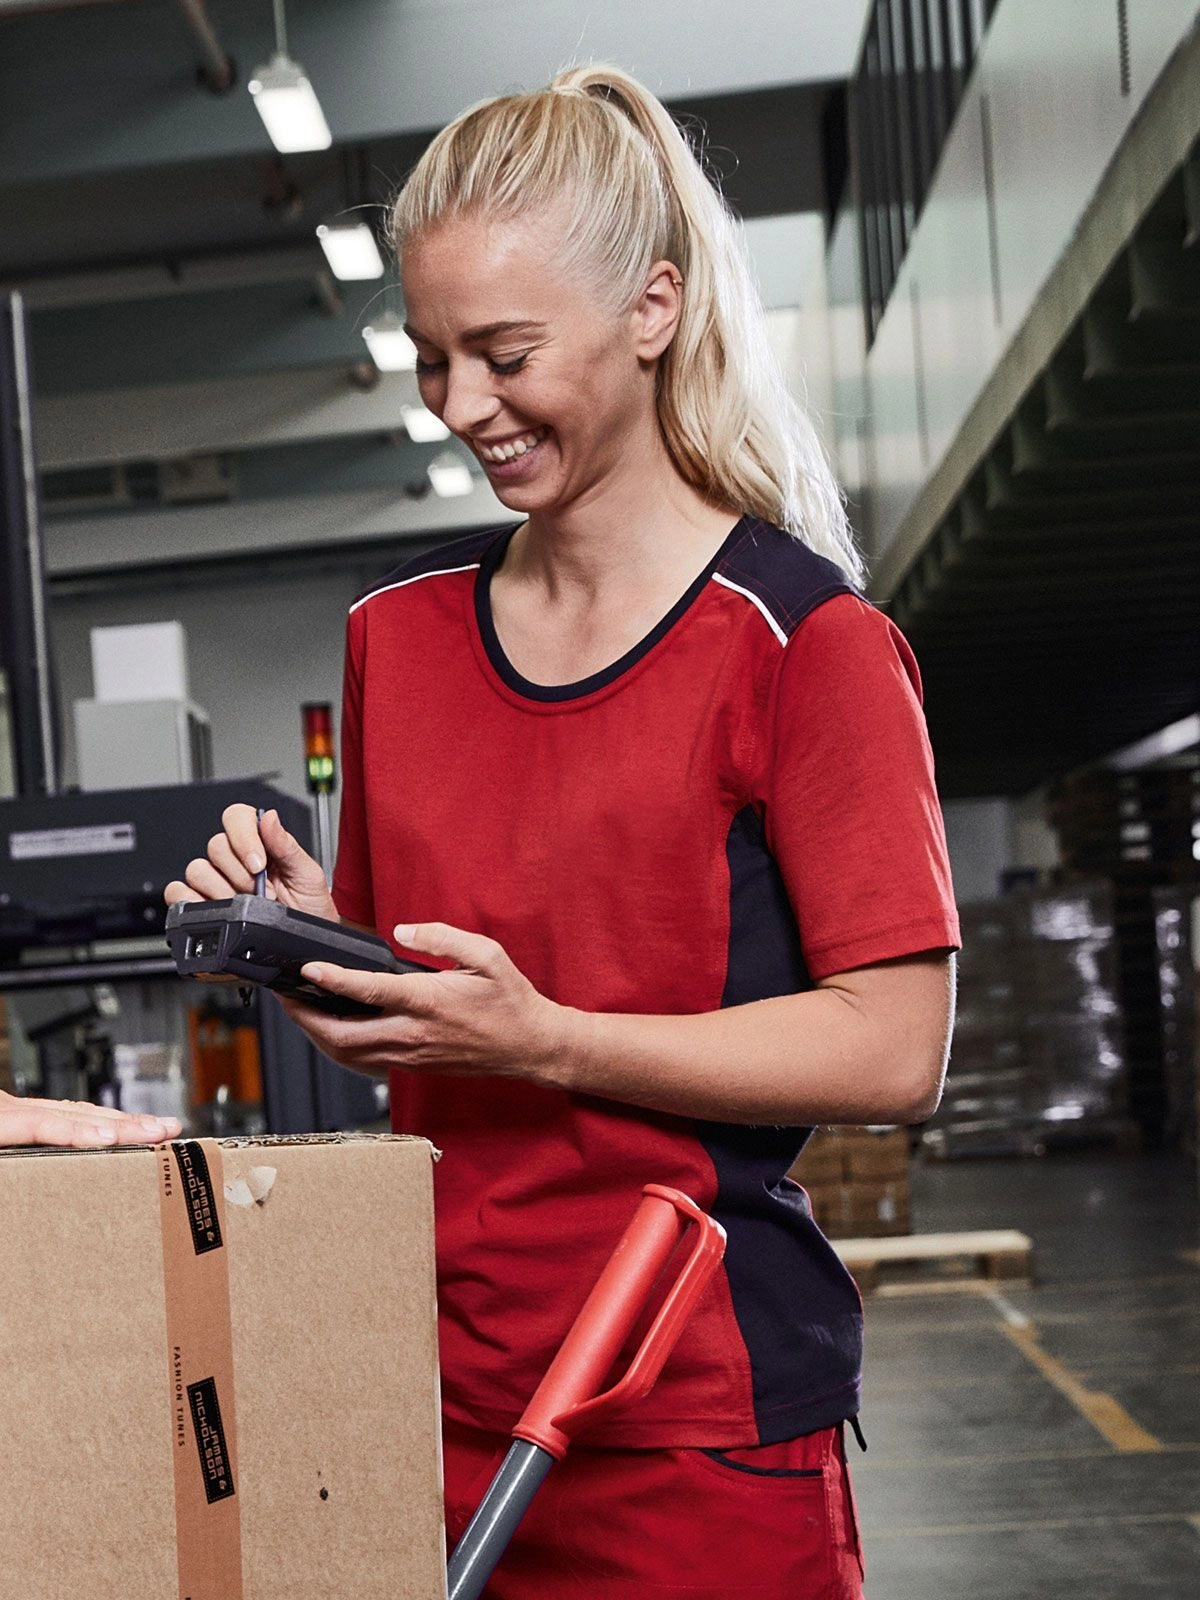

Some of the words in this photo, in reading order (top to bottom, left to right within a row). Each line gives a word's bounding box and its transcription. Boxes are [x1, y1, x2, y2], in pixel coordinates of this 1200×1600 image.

[162, 1158, 172, 1197] TUNES
[179, 1142, 205, 1231] NICHOLSON
[196, 1177, 213, 1228] JAMES
[173, 1346, 184, 1401] FASHION
[176, 1407, 186, 1447] TUNES
[194, 1391, 217, 1480] NICHOLSON
[209, 1425, 225, 1477] JAMES
